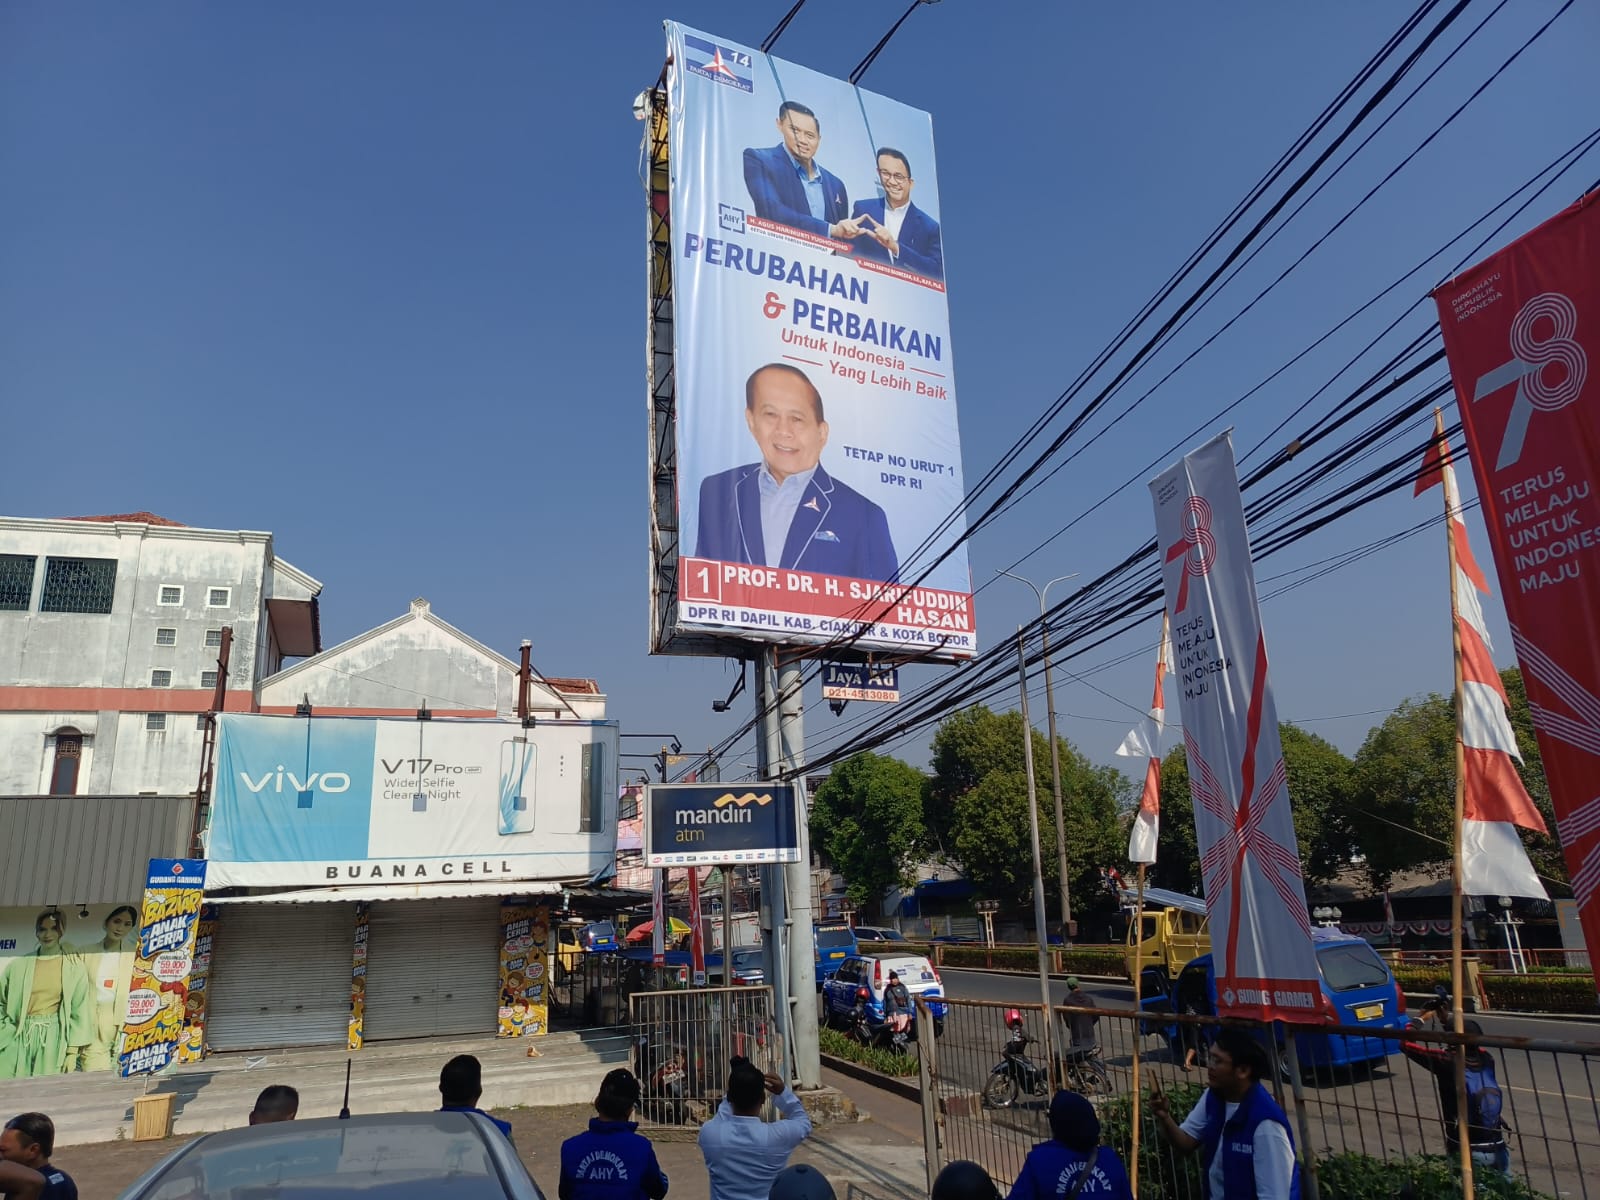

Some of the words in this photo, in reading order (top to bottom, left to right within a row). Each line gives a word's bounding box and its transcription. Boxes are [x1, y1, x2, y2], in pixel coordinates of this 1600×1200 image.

[731, 52, 749, 67] 14
[723, 212, 740, 224] AHY
[758, 220, 775, 229] AGUS
[684, 232, 869, 304] PERUBAHAN
[1451, 272, 1501, 306] DIRGAHAYU
[1454, 286, 1495, 314] REPUBLIK
[1457, 291, 1503, 323] INDONESIA
[763, 291, 786, 319] &
[792, 298, 941, 361] PERBAIKAN
[781, 327, 828, 352] Untuk
[833, 341, 905, 371] Indonesia
[829, 360, 866, 384] Yang
[870, 370, 911, 392] Lebih
[916, 381, 948, 400] Baik
[843, 446, 883, 463] TETAP
[888, 450, 907, 467] NO
[910, 456, 944, 475] URUT
[948, 465, 954, 477] 1
[880, 472, 906, 487] DPR
[910, 477, 922, 490] RI
[1500, 466, 1565, 504] TERUS
[1505, 480, 1590, 527] MELAJU
[1509, 509, 1581, 549] UNTUK
[697, 567, 709, 594] 1
[724, 565, 781, 589] PROF.
[787, 574, 818, 594] DR.
[825, 579, 844, 598] H.
[849, 581, 967, 611] SJARIFUDDIN
[1520, 560, 1580, 594] MAJU
[688, 606, 718, 620] DPR
[721, 608, 736, 621] RI
[740, 611, 780, 627] DAPIL
[783, 616, 815, 630] KAB.
[880, 626, 889, 638] &
[892, 628, 925, 643] KOTA
[897, 607, 968, 629] HASAN
[239, 764, 351, 793] vivo
[381, 759, 433, 774] V17
[434, 764, 463, 774] Pro
[383, 790, 423, 799] Clearer
[428, 790, 461, 801] Night
[384, 778, 419, 788] Wider
[423, 777, 455, 788] Selfie
[675, 803, 751, 825] mandiri
[675, 828, 705, 842] atm
[326, 863, 427, 879] BUANA
[441, 860, 512, 877] CELL
[144, 891, 201, 928] BAZAAR
[150, 914, 188, 939] ANAK
[148, 929, 184, 953] CERIA
[1274, 990, 1315, 1008] GARMEN
[123, 1024, 180, 1054] BAZAAR
[127, 1054, 166, 1075] CERIA
[129, 1043, 169, 1063] ANAK
[589, 1167, 614, 1180] AHY
